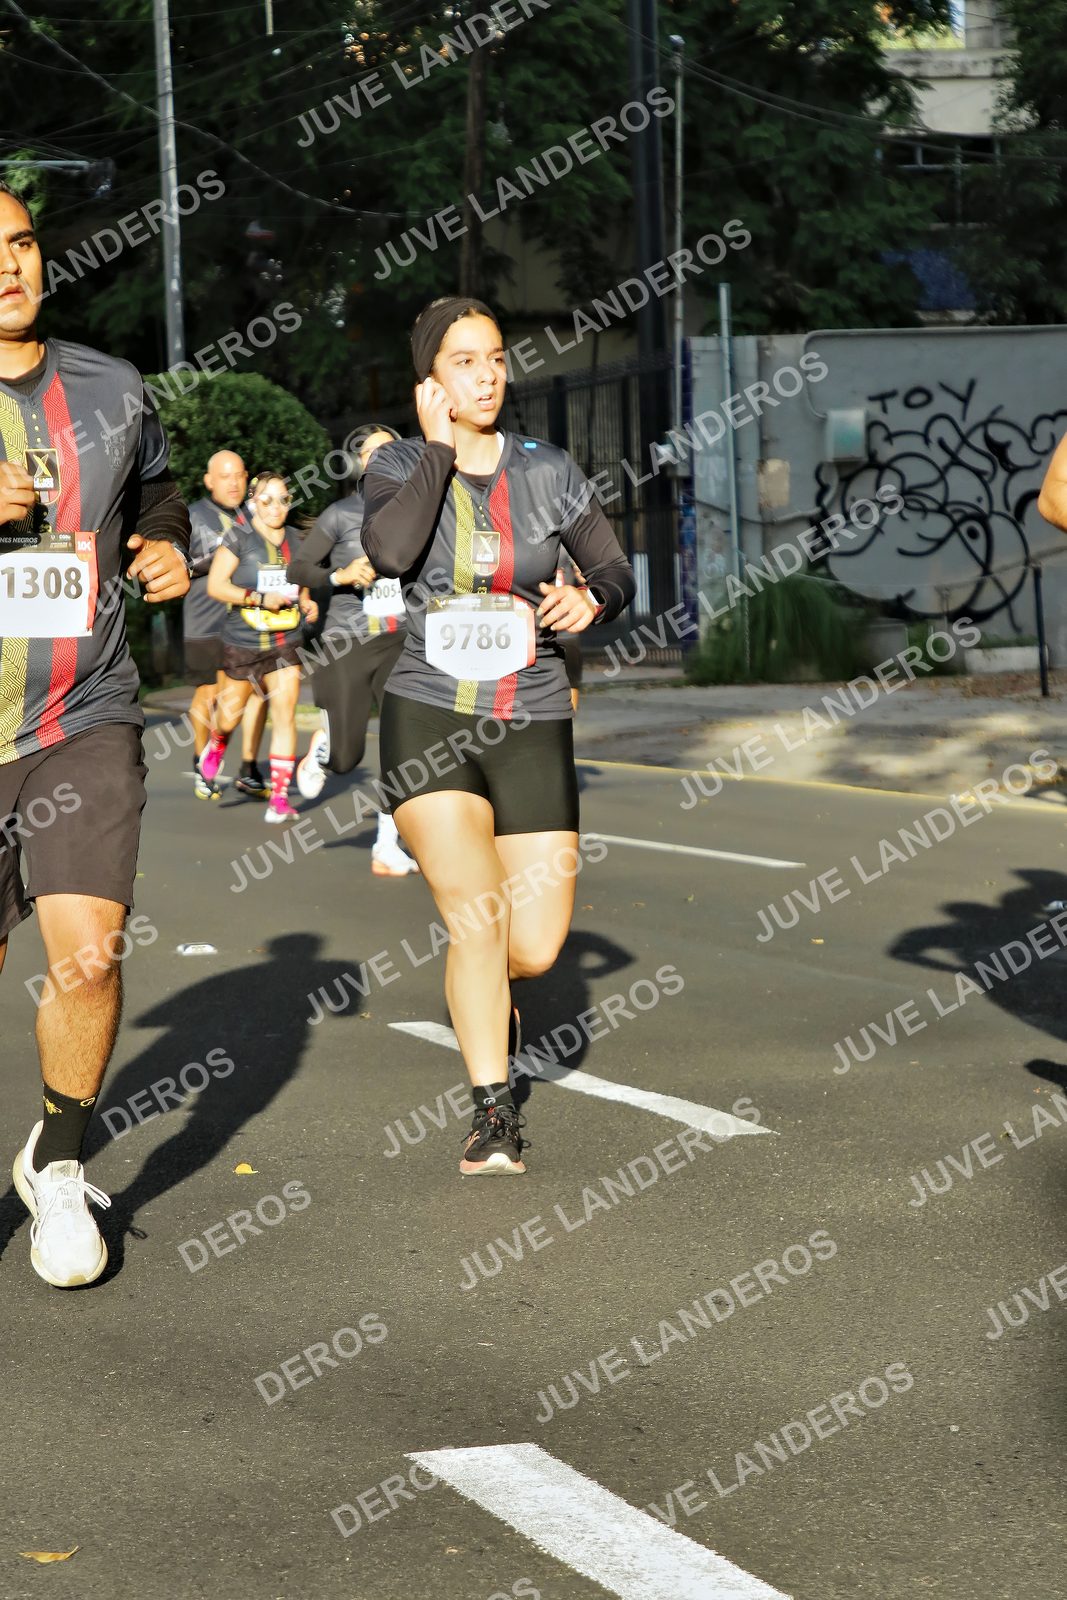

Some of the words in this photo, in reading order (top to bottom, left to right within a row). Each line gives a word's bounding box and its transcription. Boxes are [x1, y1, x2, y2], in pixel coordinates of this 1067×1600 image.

[867, 378, 976, 422] TOY
[0, 566, 83, 600] 1308
[440, 623, 511, 650] 9786
